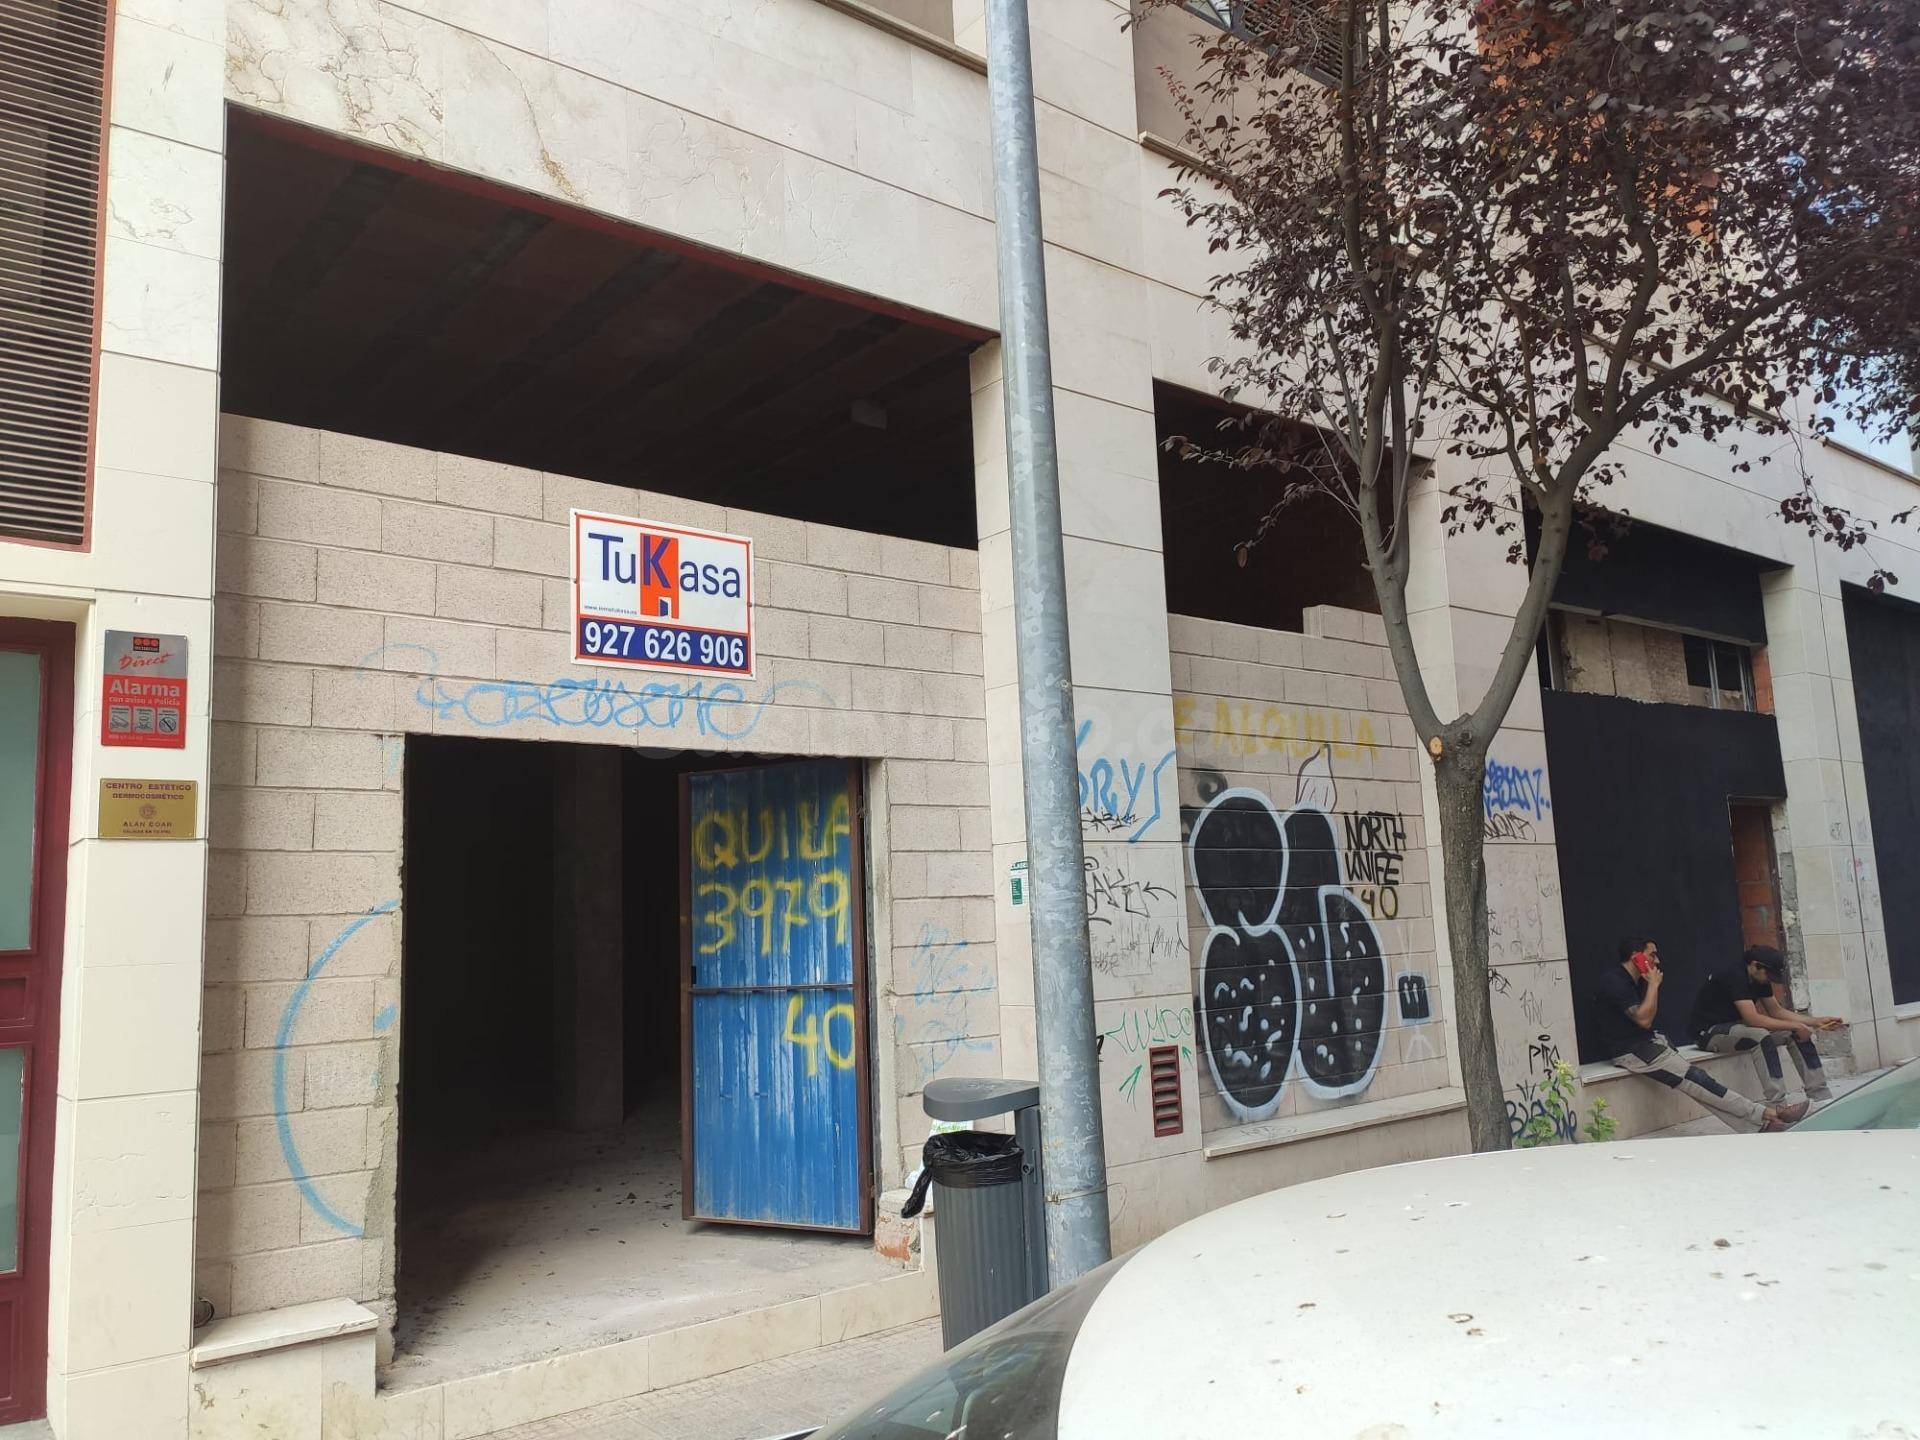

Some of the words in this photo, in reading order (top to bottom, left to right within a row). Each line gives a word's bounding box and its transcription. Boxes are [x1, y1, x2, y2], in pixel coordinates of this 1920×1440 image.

[588, 532, 741, 599] TuKasa
[118, 652, 175, 671] Direct
[585, 621, 636, 656] 927
[644, 628, 692, 662] 626
[700, 634, 744, 667] 906
[109, 679, 181, 697] Alarma
[105, 782, 143, 790] CENTRO
[1343, 810, 1407, 853] NORTH
[697, 867, 850, 956] 3979
[1360, 885, 1399, 920] 40
[782, 994, 856, 1077] 40
